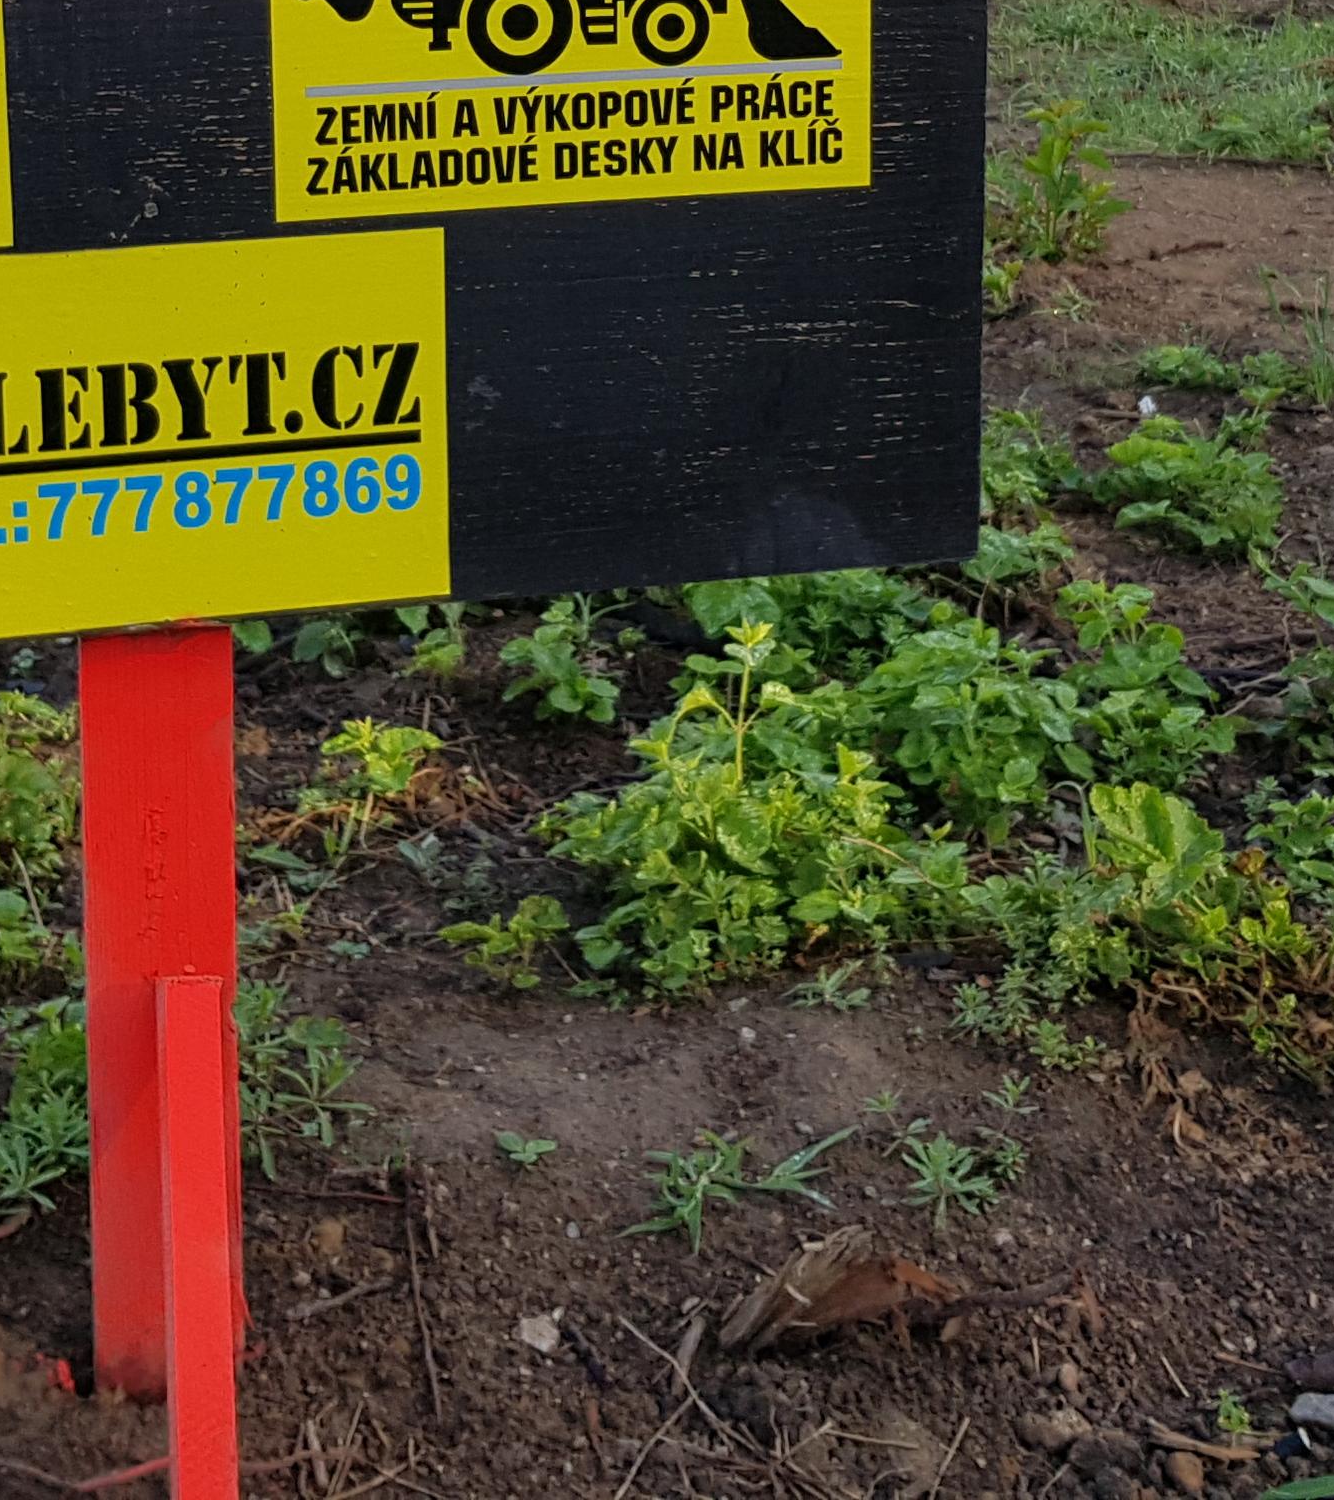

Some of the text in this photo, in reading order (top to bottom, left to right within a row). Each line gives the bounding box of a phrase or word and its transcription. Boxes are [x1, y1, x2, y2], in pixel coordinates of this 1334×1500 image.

[315, 73, 834, 146] ZEMNÍ A VÝKOPOVÉ PRÁCE
[306, 117, 842, 196] ZÁKLADOVÉ DESKY NA KLÍČ
